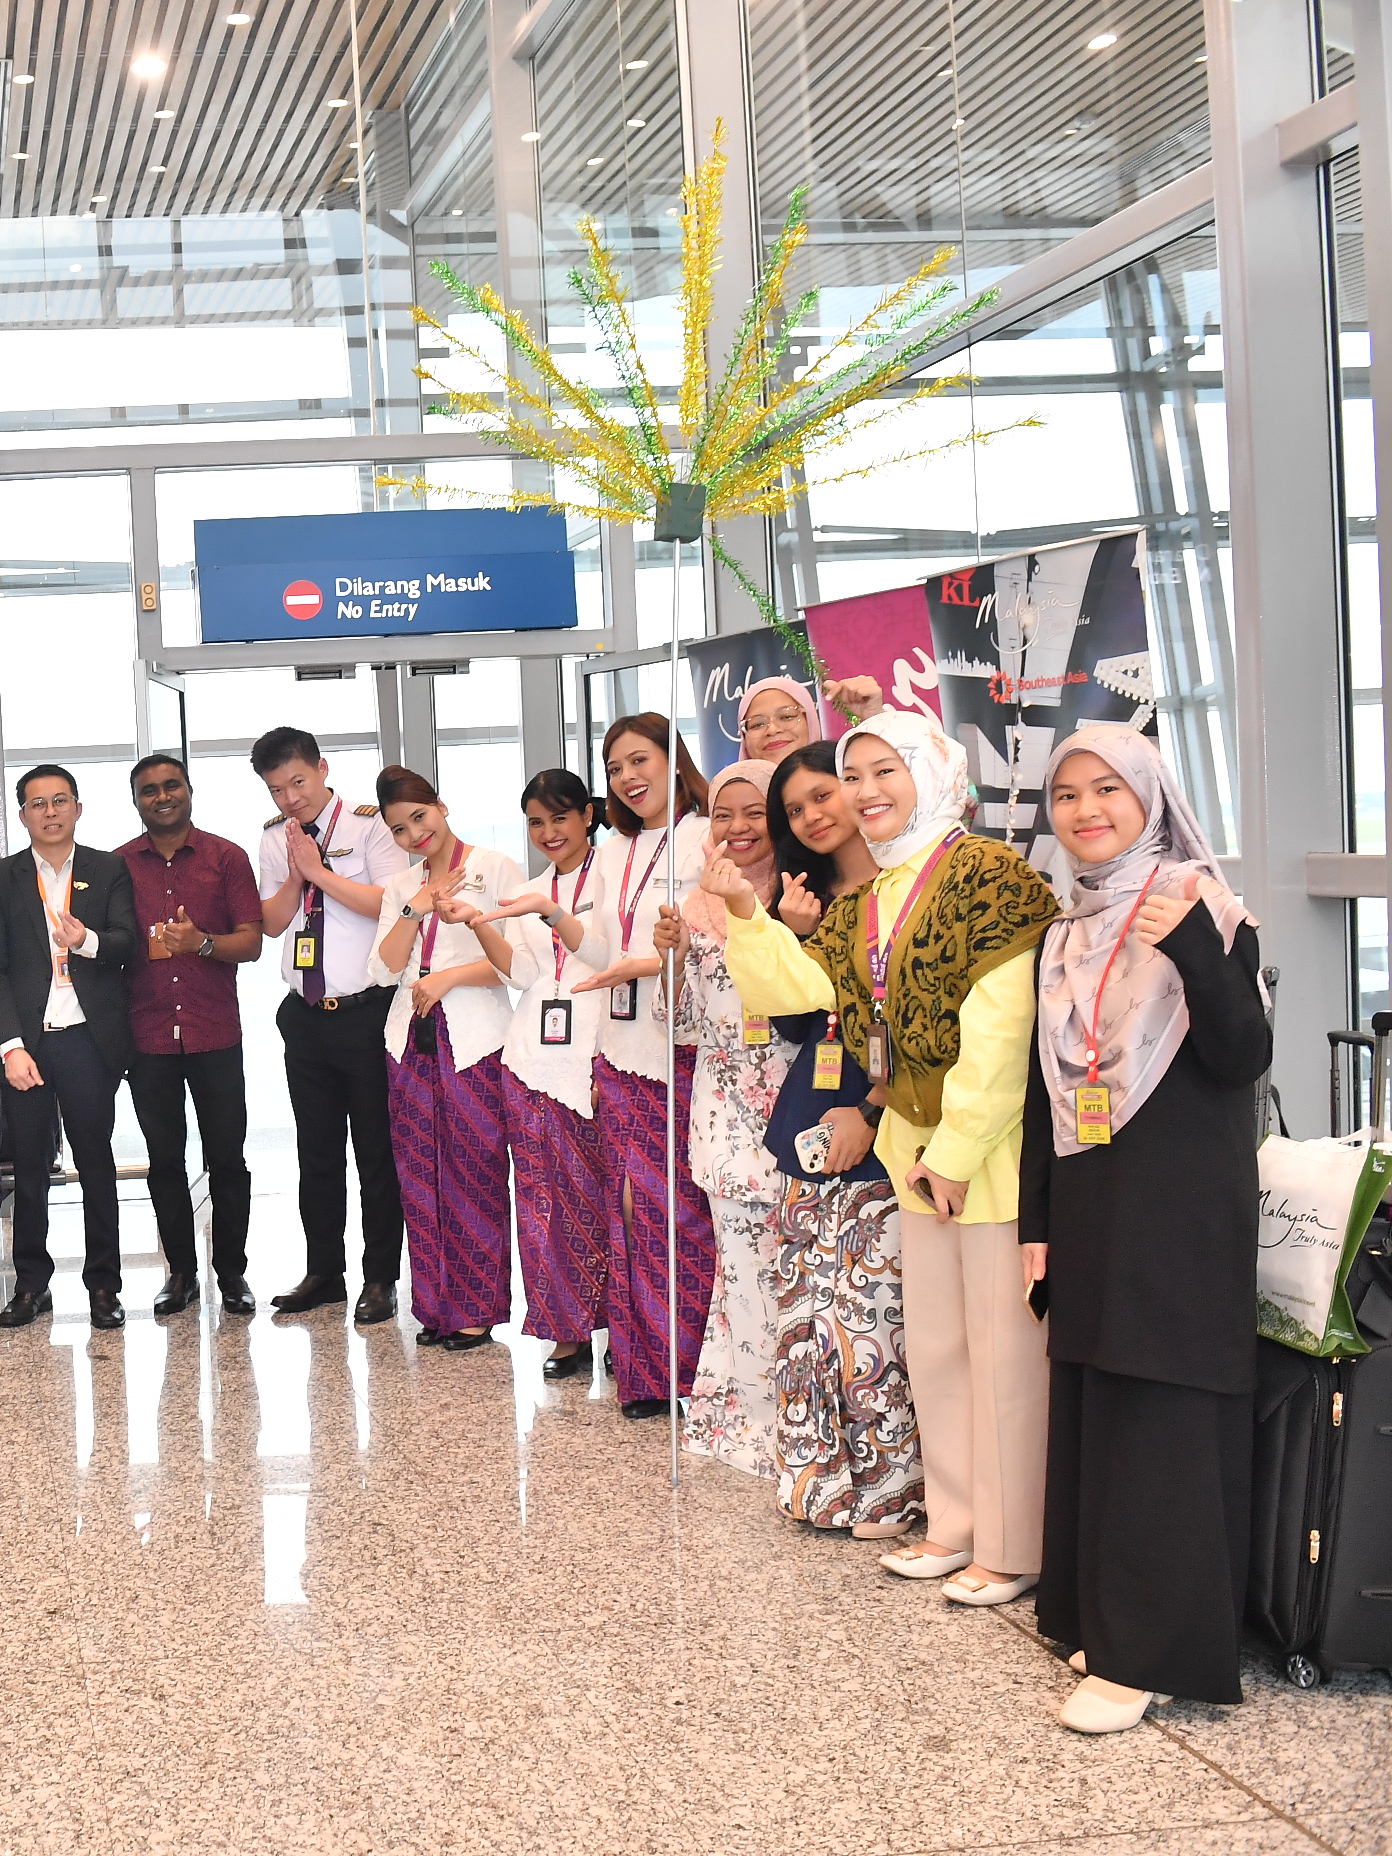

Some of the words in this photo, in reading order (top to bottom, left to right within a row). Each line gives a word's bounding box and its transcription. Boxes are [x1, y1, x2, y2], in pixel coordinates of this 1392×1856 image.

[335, 577, 421, 599] Dilarang
[426, 571, 492, 593] Masuk
[940, 578, 980, 607] KL
[337, 601, 363, 620] No
[370, 600, 419, 621] Entry
[975, 591, 1080, 654] Malaysia
[1083, 1104, 1104, 1112] MTB
[1293, 1227, 1319, 1246] Truly
[1319, 1234, 1340, 1251] Asia
